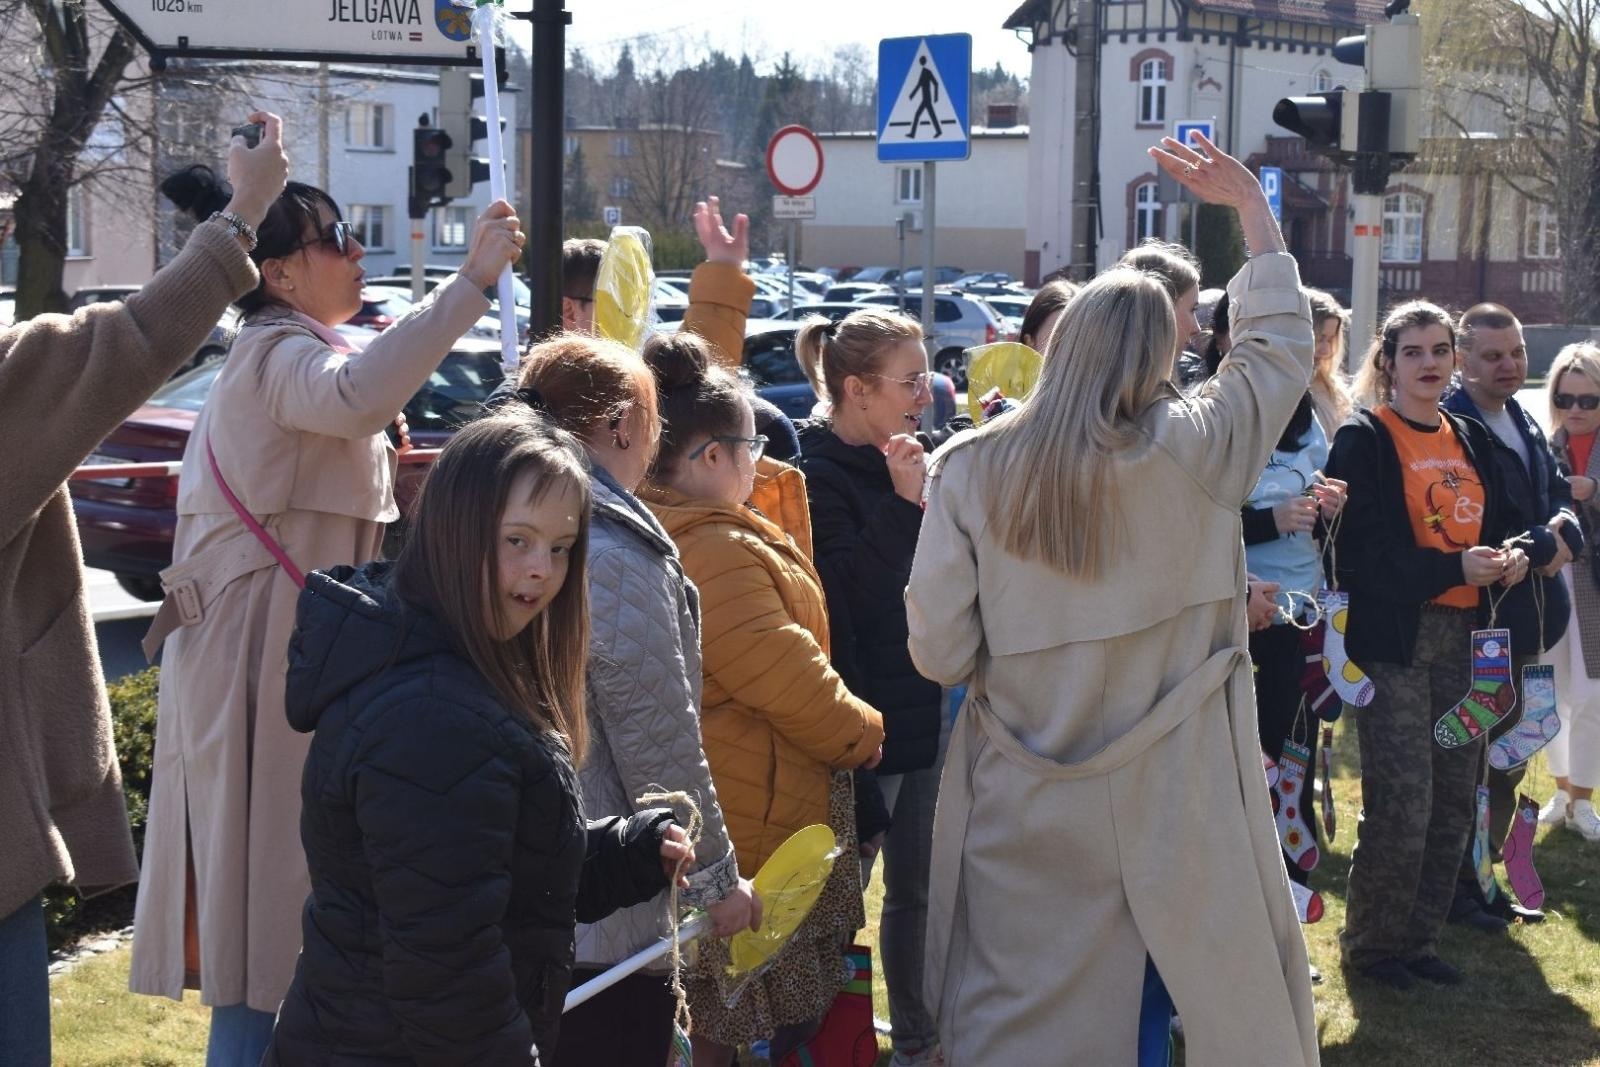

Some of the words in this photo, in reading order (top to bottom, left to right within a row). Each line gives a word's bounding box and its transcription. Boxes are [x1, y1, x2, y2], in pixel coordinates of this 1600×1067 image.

[151, 0, 185, 12] 1025
[187, 1, 203, 13] km
[328, 0, 422, 25] JELGAVA
[371, 30, 403, 41] ŁOTWA
[1265, 172, 1278, 200] P
